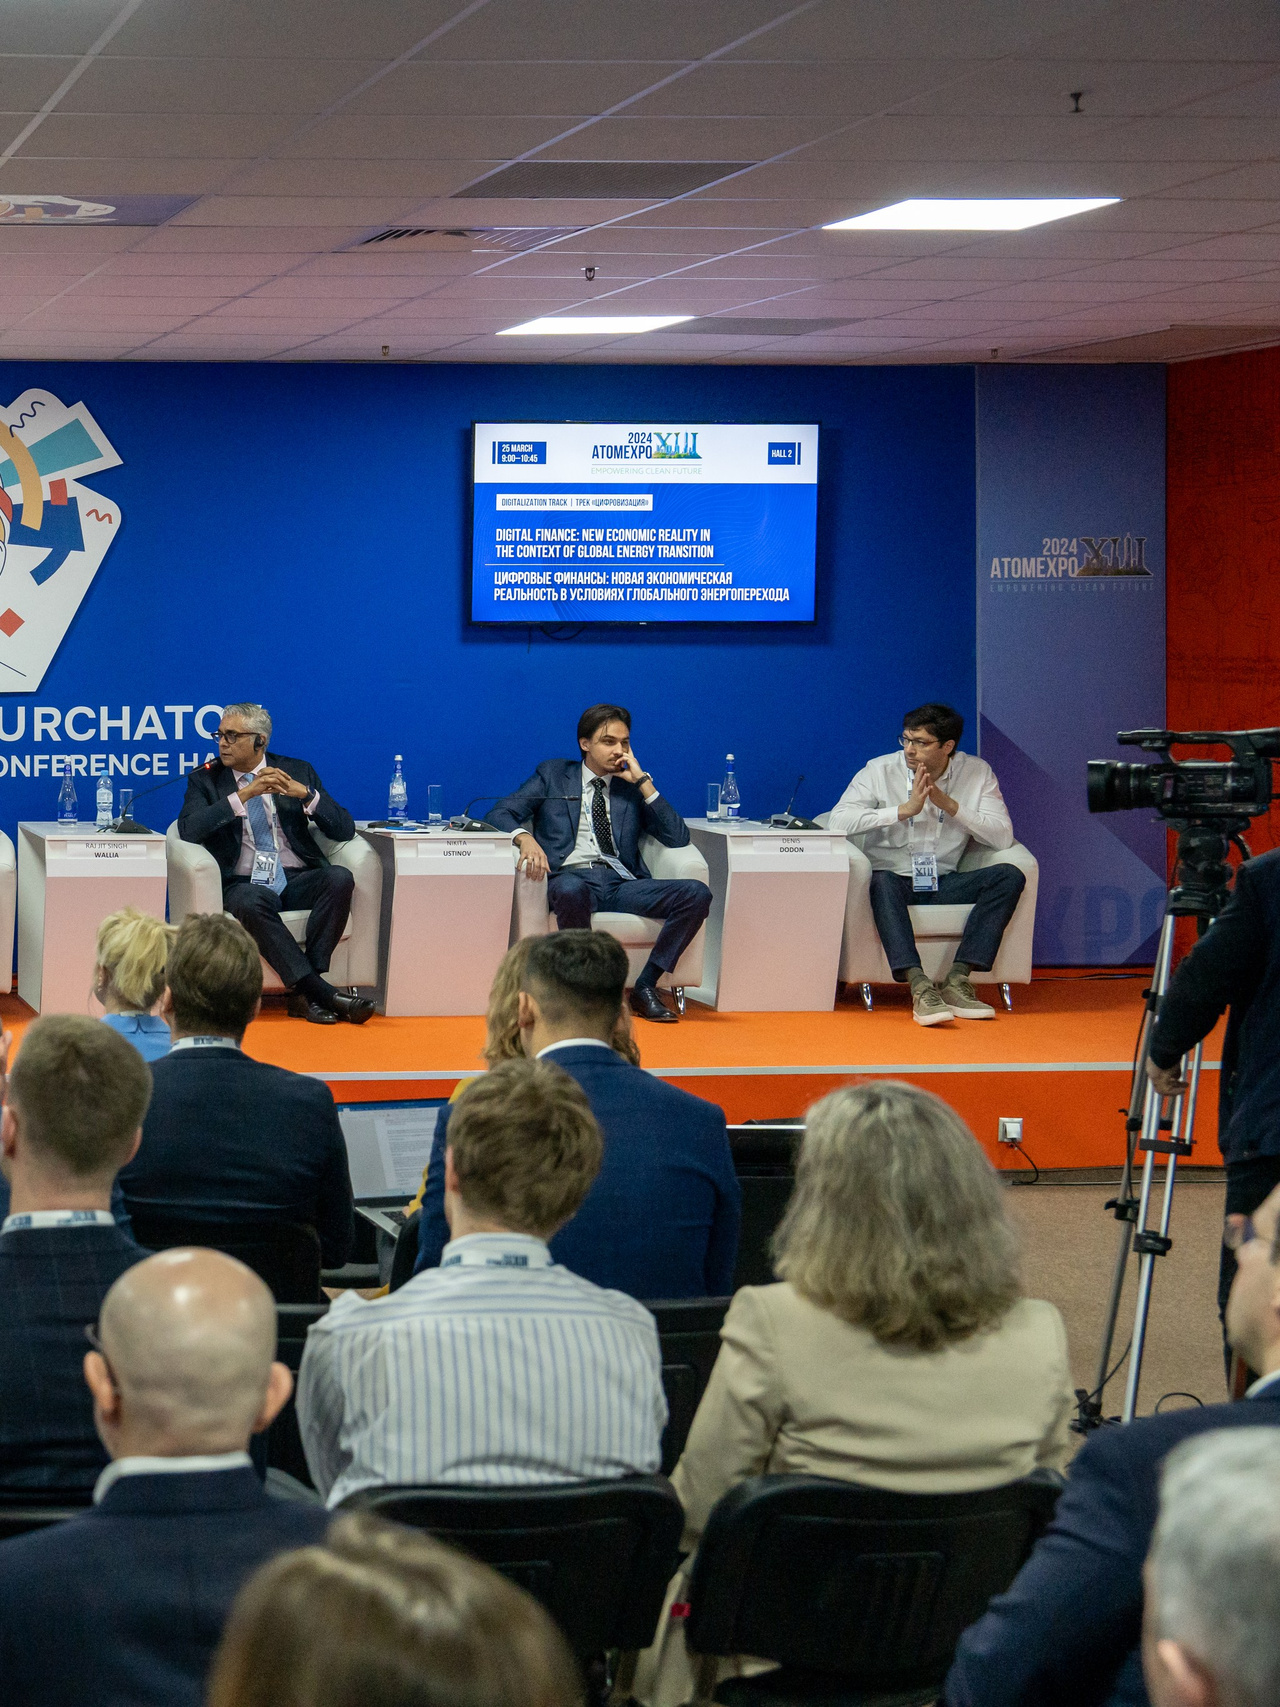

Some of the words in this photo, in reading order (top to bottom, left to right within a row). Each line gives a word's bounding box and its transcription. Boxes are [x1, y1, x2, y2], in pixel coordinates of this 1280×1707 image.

[628, 432, 652, 444] 2024
[501, 444, 510, 453] 25
[511, 444, 533, 453] MARCH
[592, 445, 652, 459] ATOMEXPO
[772, 450, 786, 458] HALL
[787, 450, 792, 458] 2
[501, 498, 546, 507] DIGITALIZATION
[548, 498, 568, 507] TRACK
[576, 499, 590, 507] ТРЕК
[496, 528, 533, 542] DIGITAL
[535, 529, 579, 542] FINANCE:
[582, 529, 604, 542] NEW
[606, 529, 656, 542] ECONOMIC
[658, 529, 698, 542] REALITY
[700, 529, 711, 542] IN
[495, 545, 515, 558] THE
[516, 545, 561, 558] CONTEXT
[563, 545, 576, 558] OF
[577, 545, 615, 558] GLOBAL
[617, 545, 655, 558] ENERGY
[657, 545, 714, 558] TRANSITION
[1042, 538, 1078, 556] 2024
[990, 557, 1078, 578] ATOMEXPO
[494, 571, 552, 586] ЦИФРОВЫЕ
[554, 571, 610, 586] ФИНАНСЫ:
[611, 571, 644, 585] НОВАЯ
[646, 572, 732, 585] ЭКОНОМИЧЕСКАЯ
[494, 588, 559, 602] РЕАЛЬНОСТЬ
[560, 588, 568, 601] В
[569, 588, 625, 601] УСЛОВИЯХ
[627, 588, 699, 601] ГЛОБАЛЬНОГО
[701, 588, 790, 603] ЭНЕРГОПЕРЕХОДА
